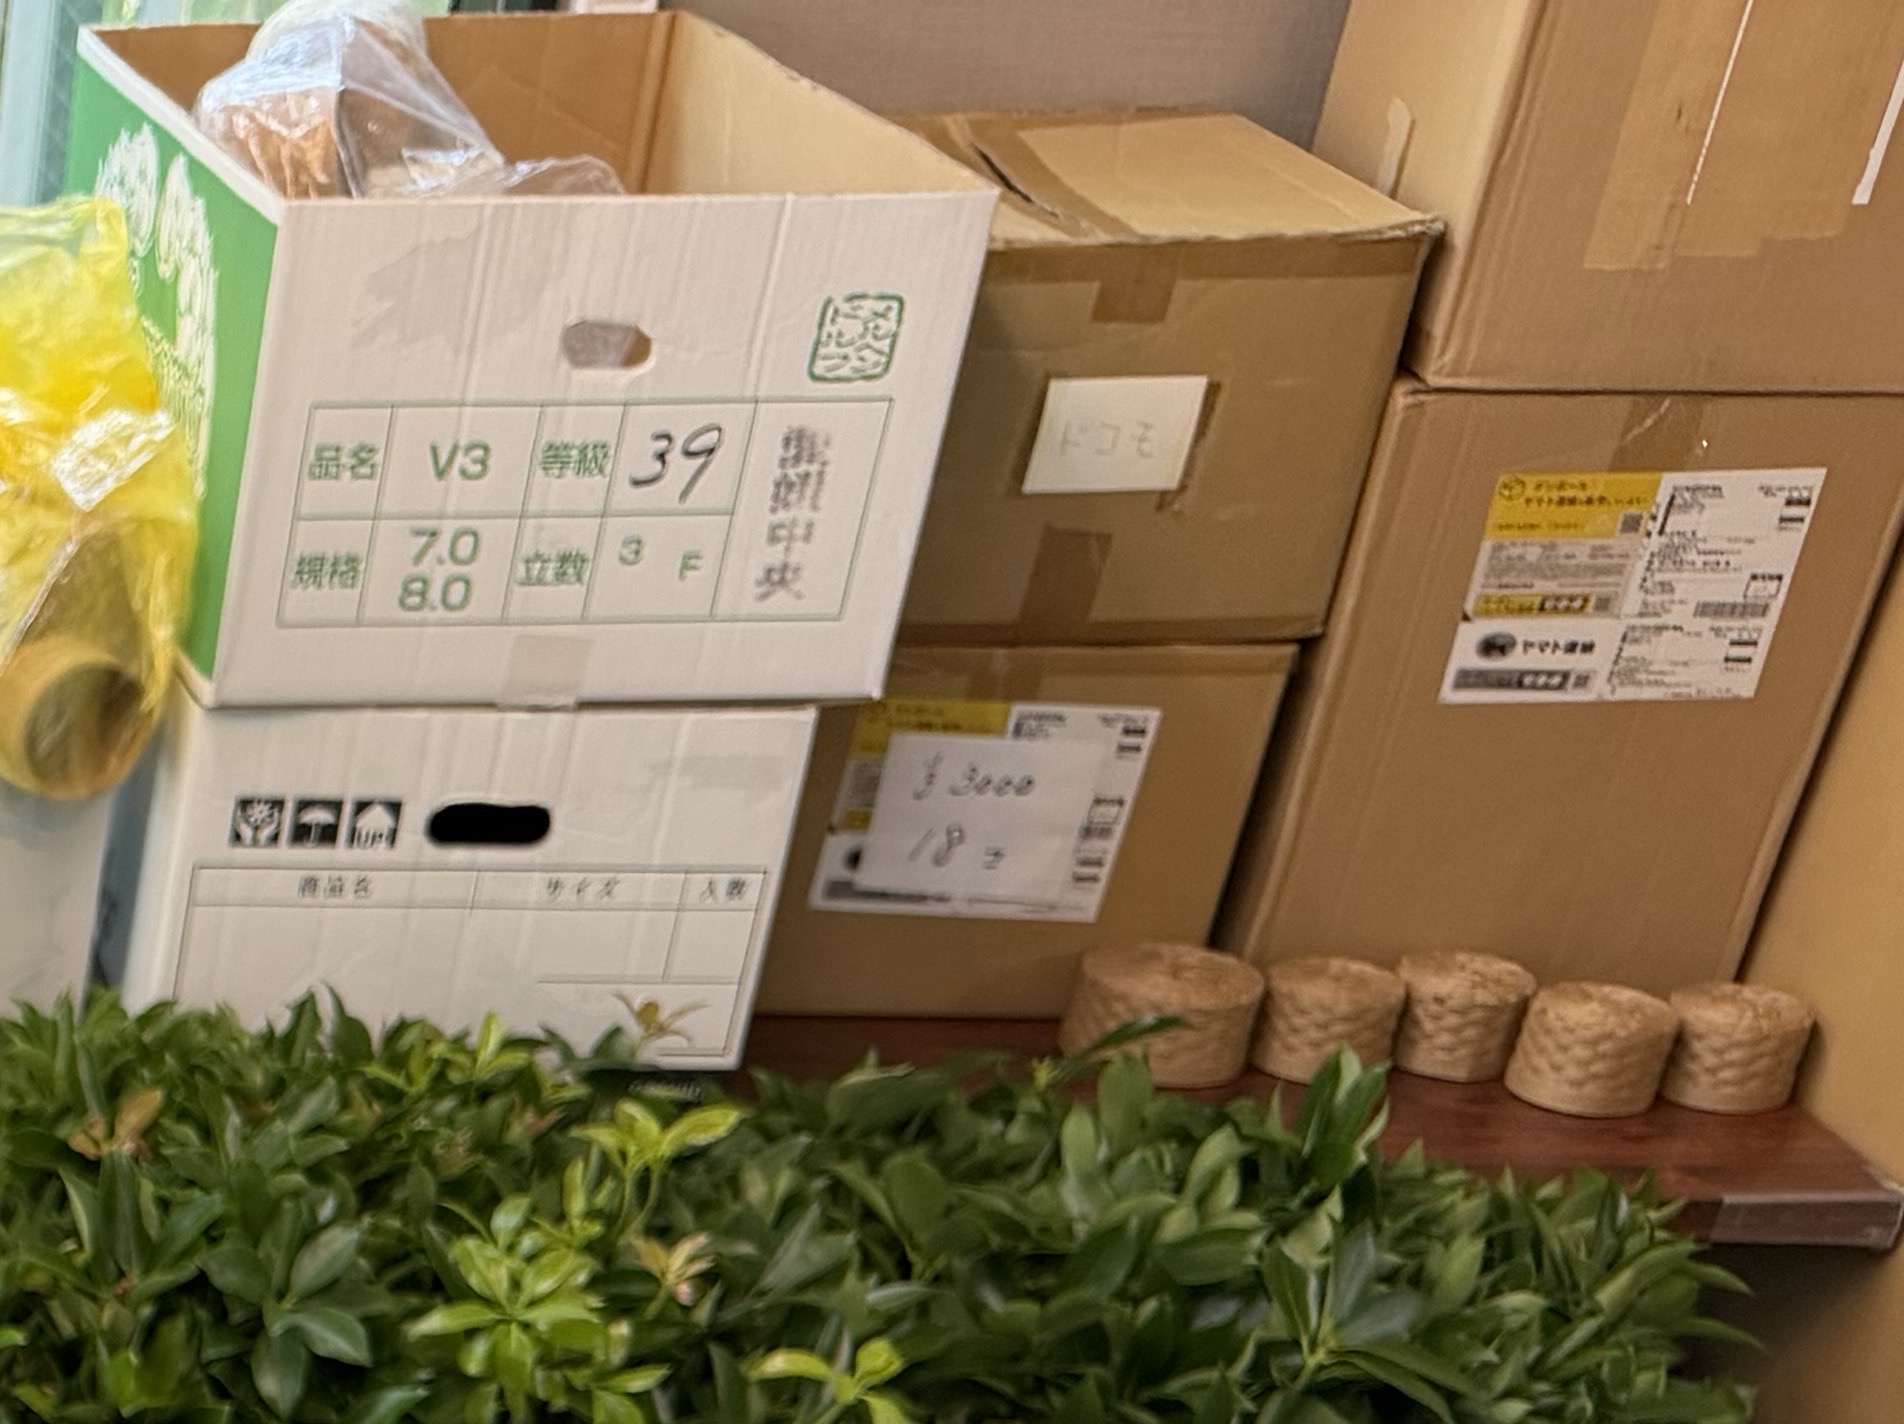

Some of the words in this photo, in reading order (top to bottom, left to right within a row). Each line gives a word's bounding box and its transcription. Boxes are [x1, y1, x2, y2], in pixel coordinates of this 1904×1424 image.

[308, 442, 380, 481] 品名
[429, 441, 491, 481] V3
[538, 440, 611, 478] 等級
[629, 423, 723, 504] 39
[409, 526, 480, 566] 7.0
[618, 536, 644, 566] 3
[678, 550, 703, 581] F
[294, 552, 363, 590] 規格
[516, 549, 589, 587] 立数
[398, 573, 473, 612] 8.0
[544, 876, 621, 900] サイズ
